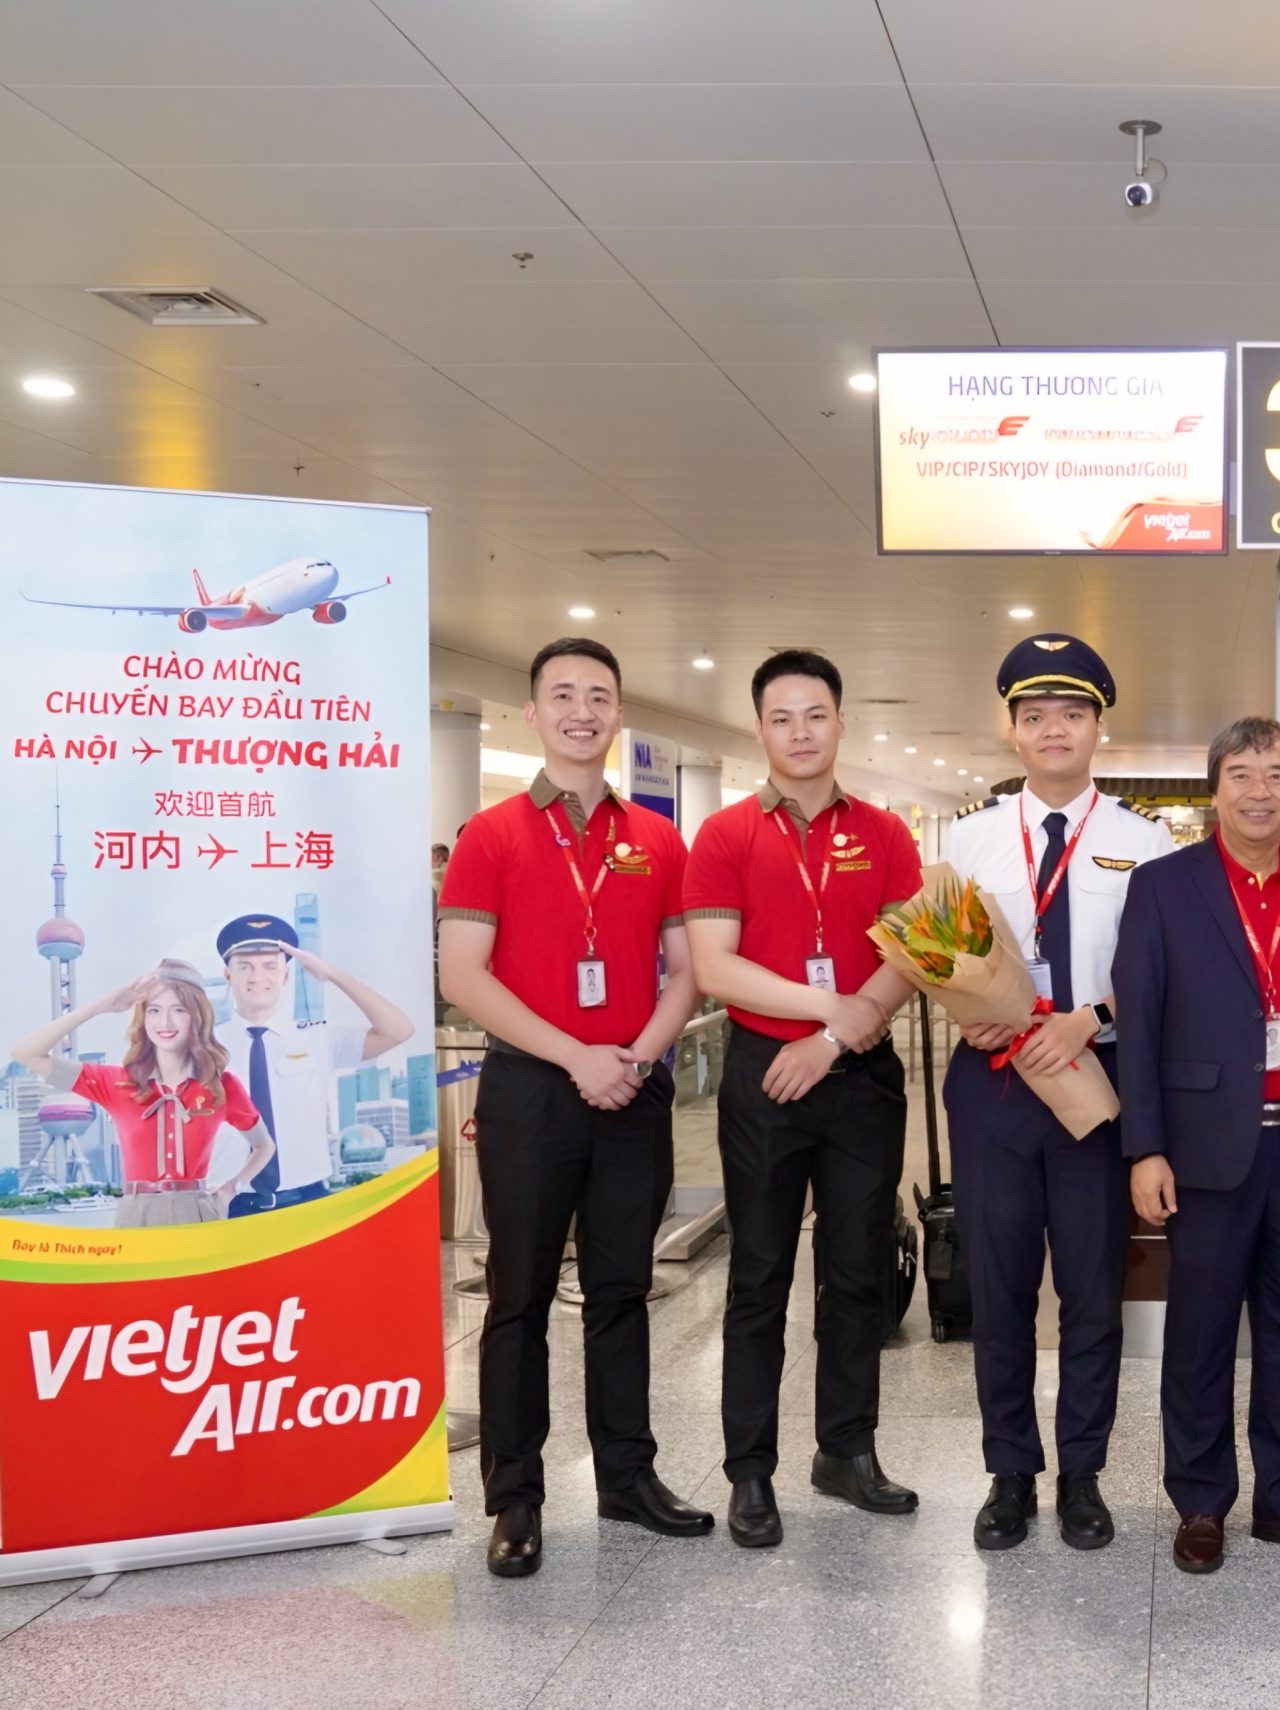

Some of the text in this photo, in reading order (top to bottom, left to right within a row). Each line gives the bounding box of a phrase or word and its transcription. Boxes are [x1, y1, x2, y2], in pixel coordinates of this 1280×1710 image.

[949, 376, 1013, 401] HẠNG
[1127, 376, 1164, 396] GIA
[916, 461, 1188, 480] VIP/CIP/SKYJOY (Diamond/Gold)
[124, 651, 301, 685] CHÀO MỪNG
[46, 684, 371, 722] CHUYẾN BAY ĐẦU TIÊN
[14, 731, 400, 773] HÀ NỘI THƯỢNG HẢI
[154, 790, 276, 818] 欢迎首航
[94, 830, 335, 870] 河内 上海
